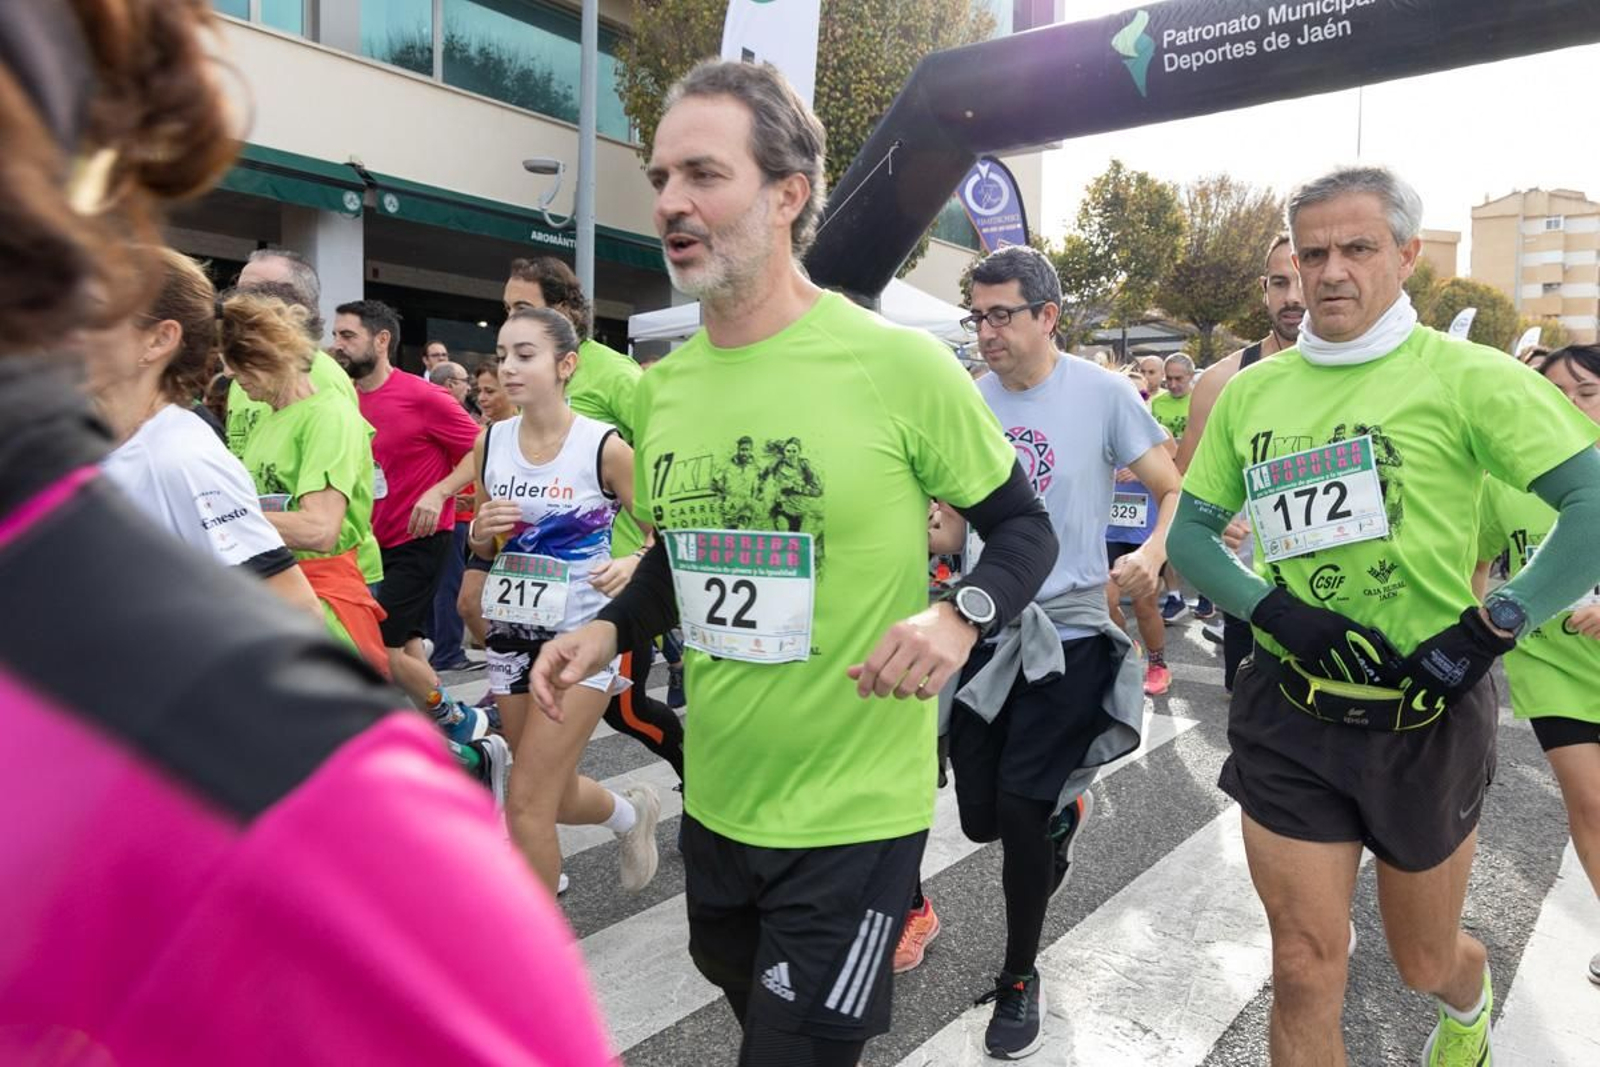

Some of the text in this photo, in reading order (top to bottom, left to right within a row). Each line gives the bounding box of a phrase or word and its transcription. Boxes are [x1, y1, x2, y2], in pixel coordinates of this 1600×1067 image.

[1163, 0, 1376, 48] Patronato Municip
[1164, 17, 1351, 73] Deportes de Jaén
[493, 475, 573, 501] calderón
[200, 507, 248, 530] Ernesto
[1111, 504, 1137, 519] 329
[1273, 481, 1353, 532] 172
[698, 533, 800, 551] CARRERA
[698, 548, 800, 567] POPULAR
[497, 578, 548, 608] 217
[1315, 575, 1346, 589] CSIF
[705, 577, 757, 629] 22
[760, 974, 796, 1001] adidas
